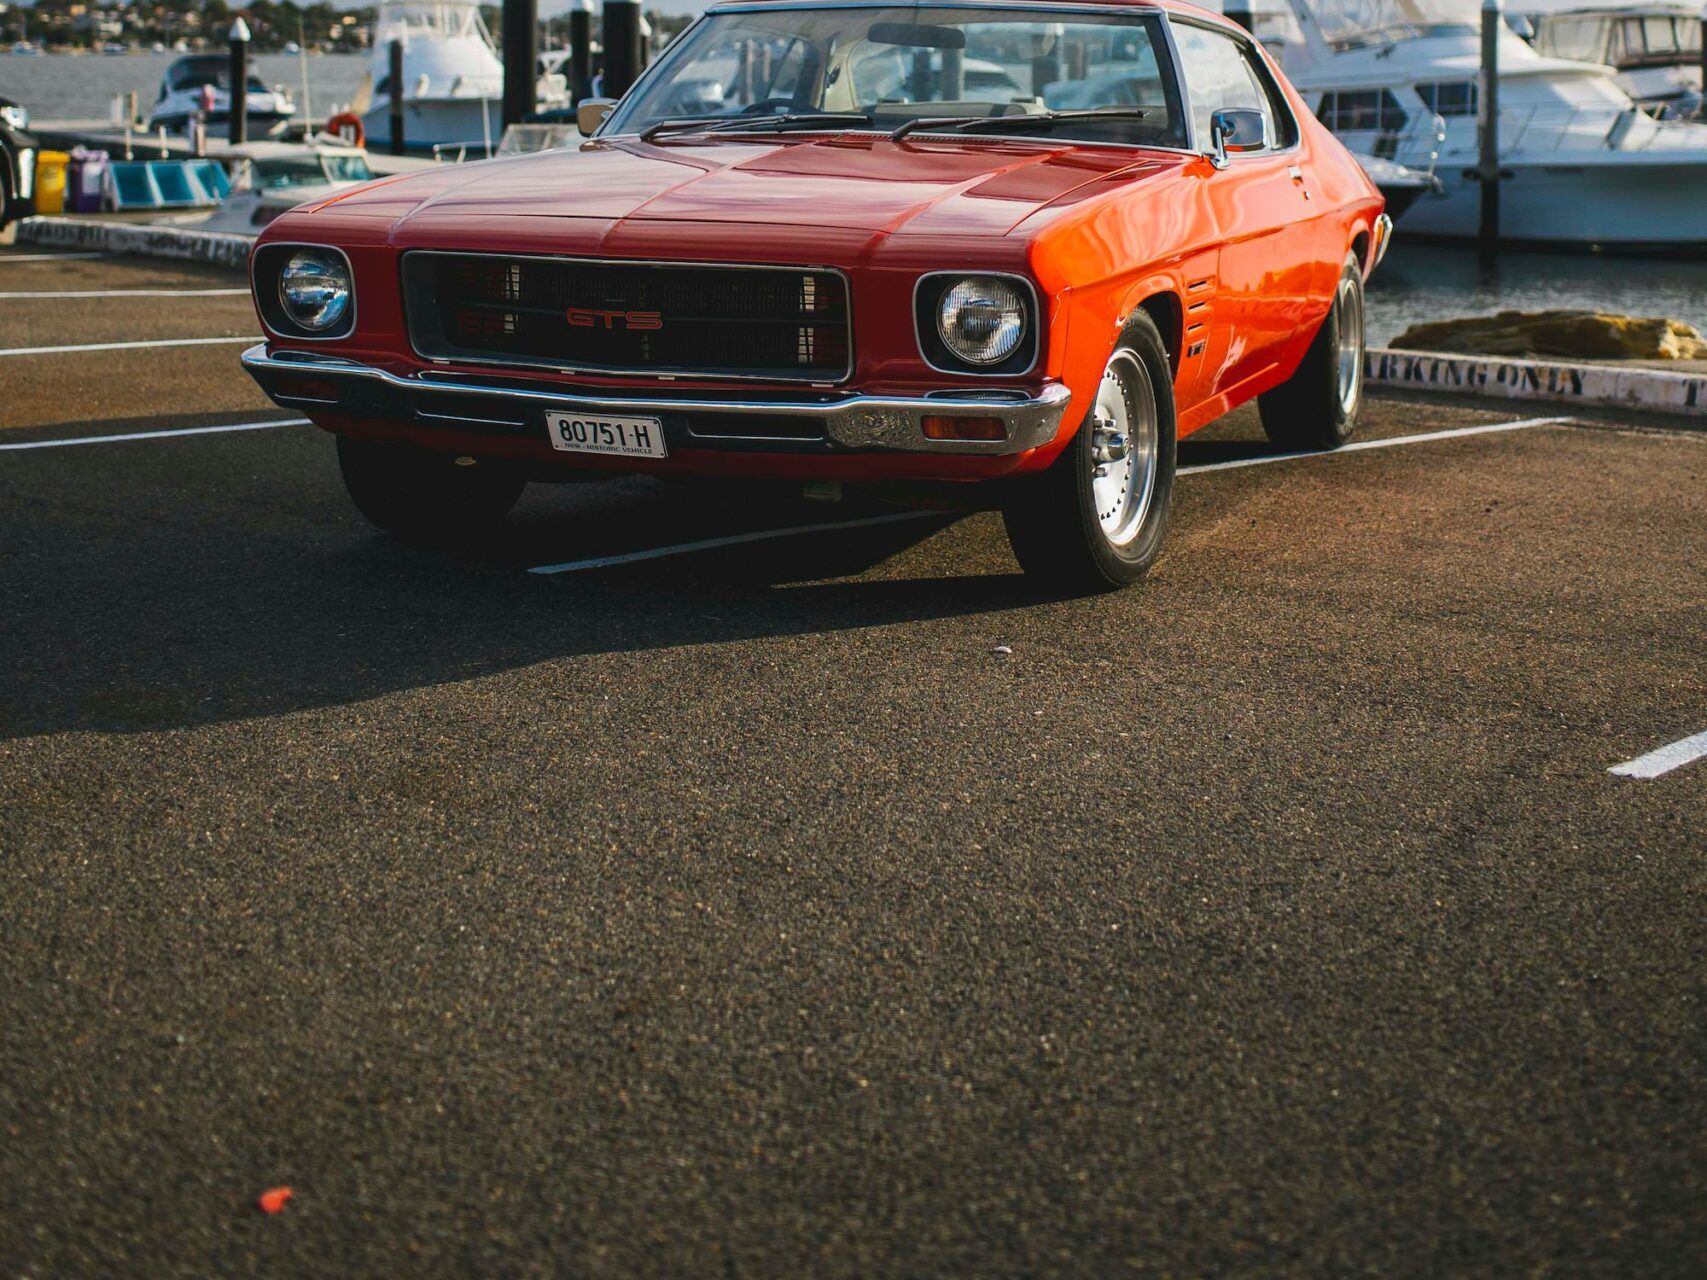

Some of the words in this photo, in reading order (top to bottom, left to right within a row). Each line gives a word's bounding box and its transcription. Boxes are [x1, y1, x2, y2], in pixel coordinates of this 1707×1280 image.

[566, 307, 663, 329] GTS
[1497, 363, 1587, 396] ONLY
[586, 444, 621, 453] HISTORIC
[622, 447, 654, 455] VEHICLE
